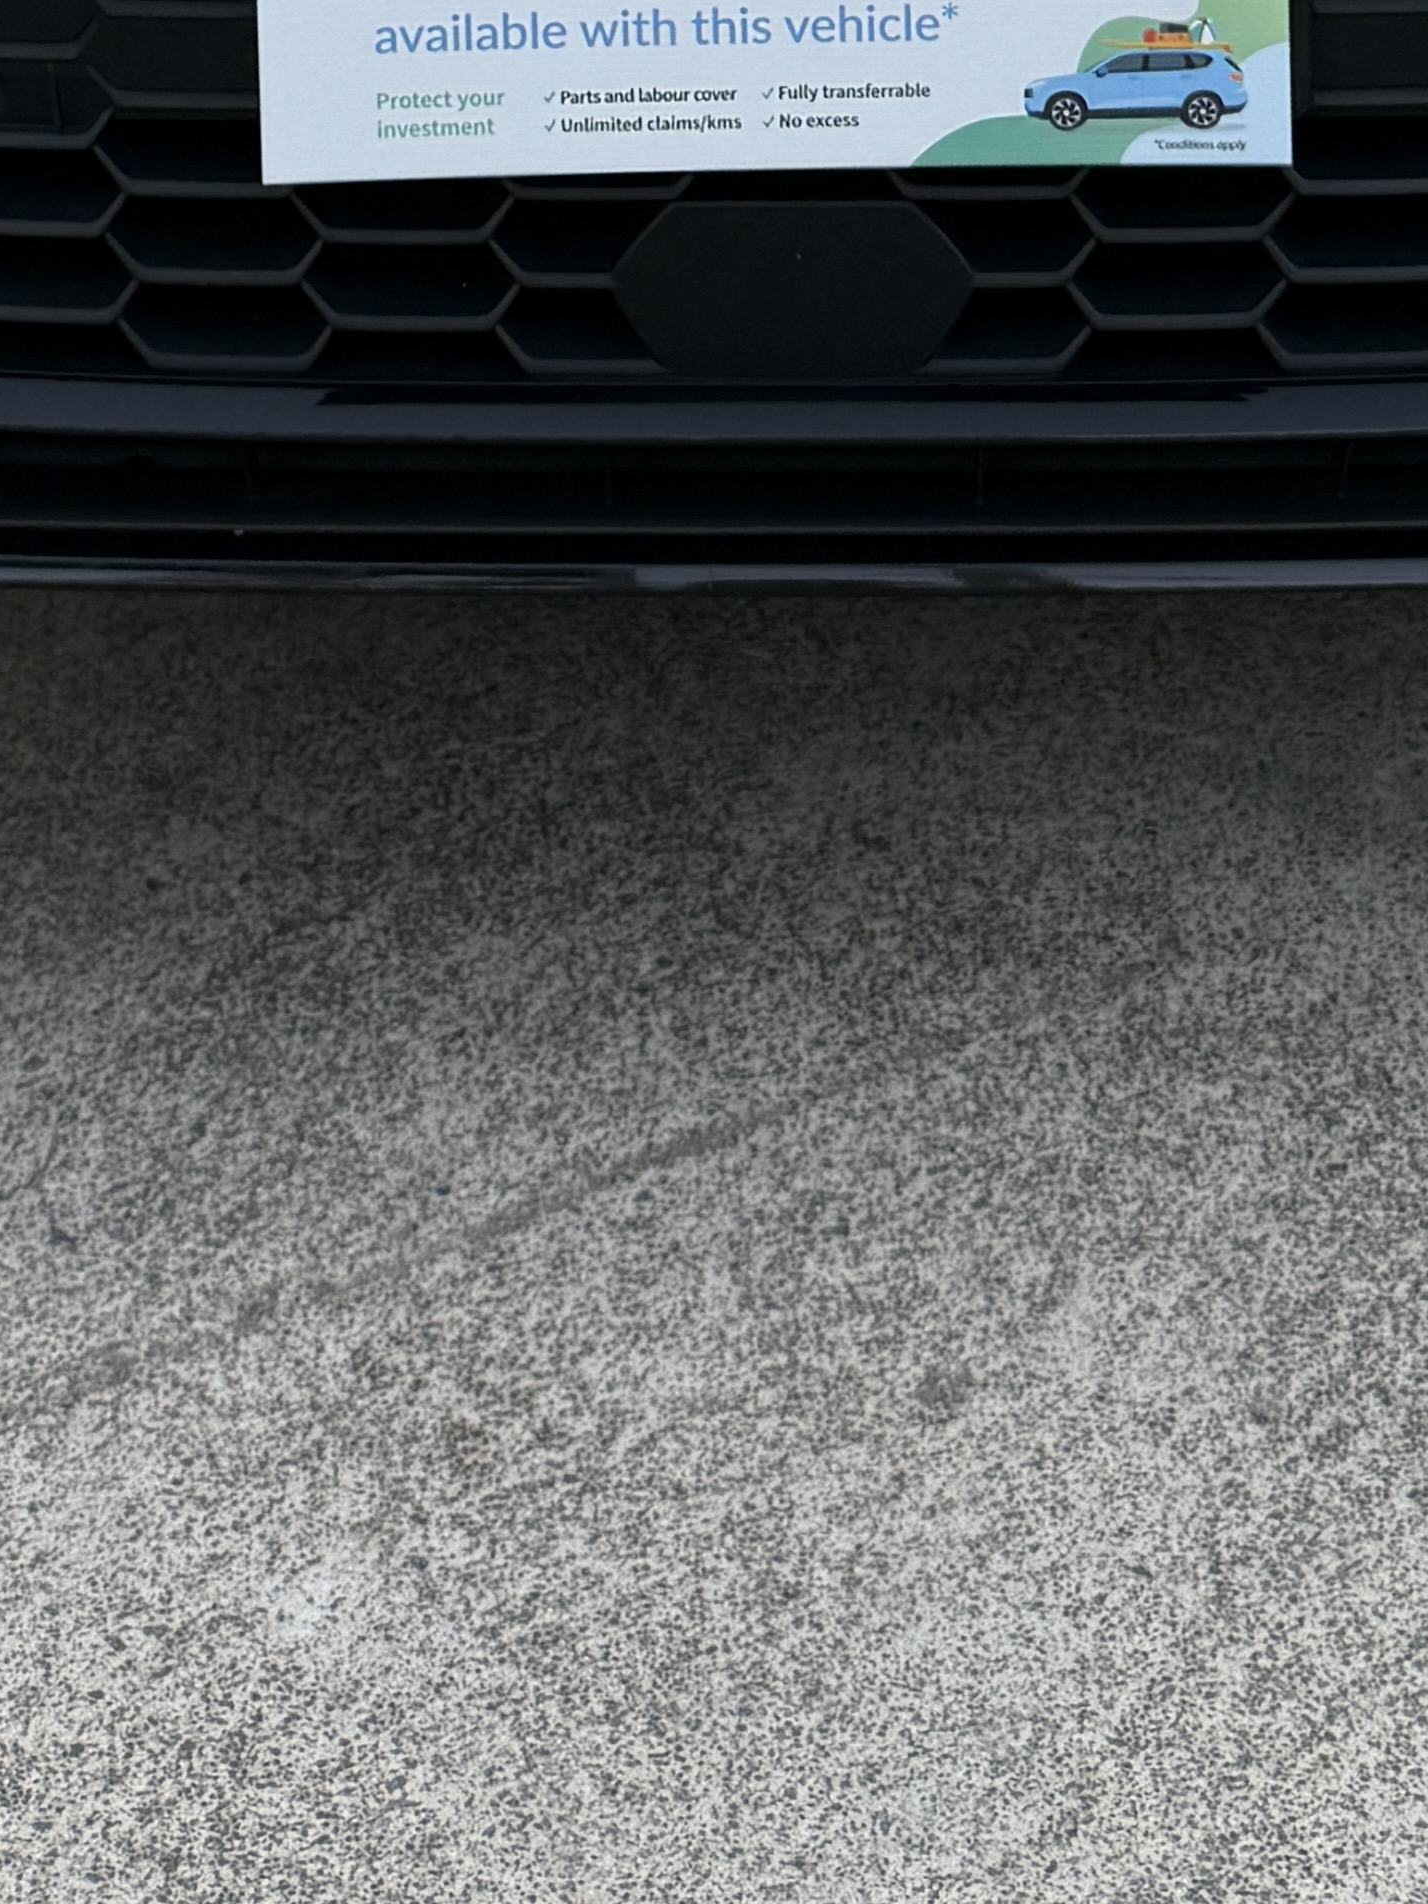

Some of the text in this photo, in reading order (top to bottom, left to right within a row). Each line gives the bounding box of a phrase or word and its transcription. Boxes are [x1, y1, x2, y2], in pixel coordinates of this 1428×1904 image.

[374, 11, 567, 55] available
[578, 7, 675, 49] with
[691, 6, 772, 47] this
[376, 91, 506, 112] Protect your
[560, 87, 738, 105] Parts and labour cover
[778, 82, 931, 103] Fully transferrable
[376, 116, 496, 139] investment
[560, 114, 743, 134] Unlimited claims/kms
[779, 113, 860, 128] No excess
[1216, 138, 1247, 152] apply
